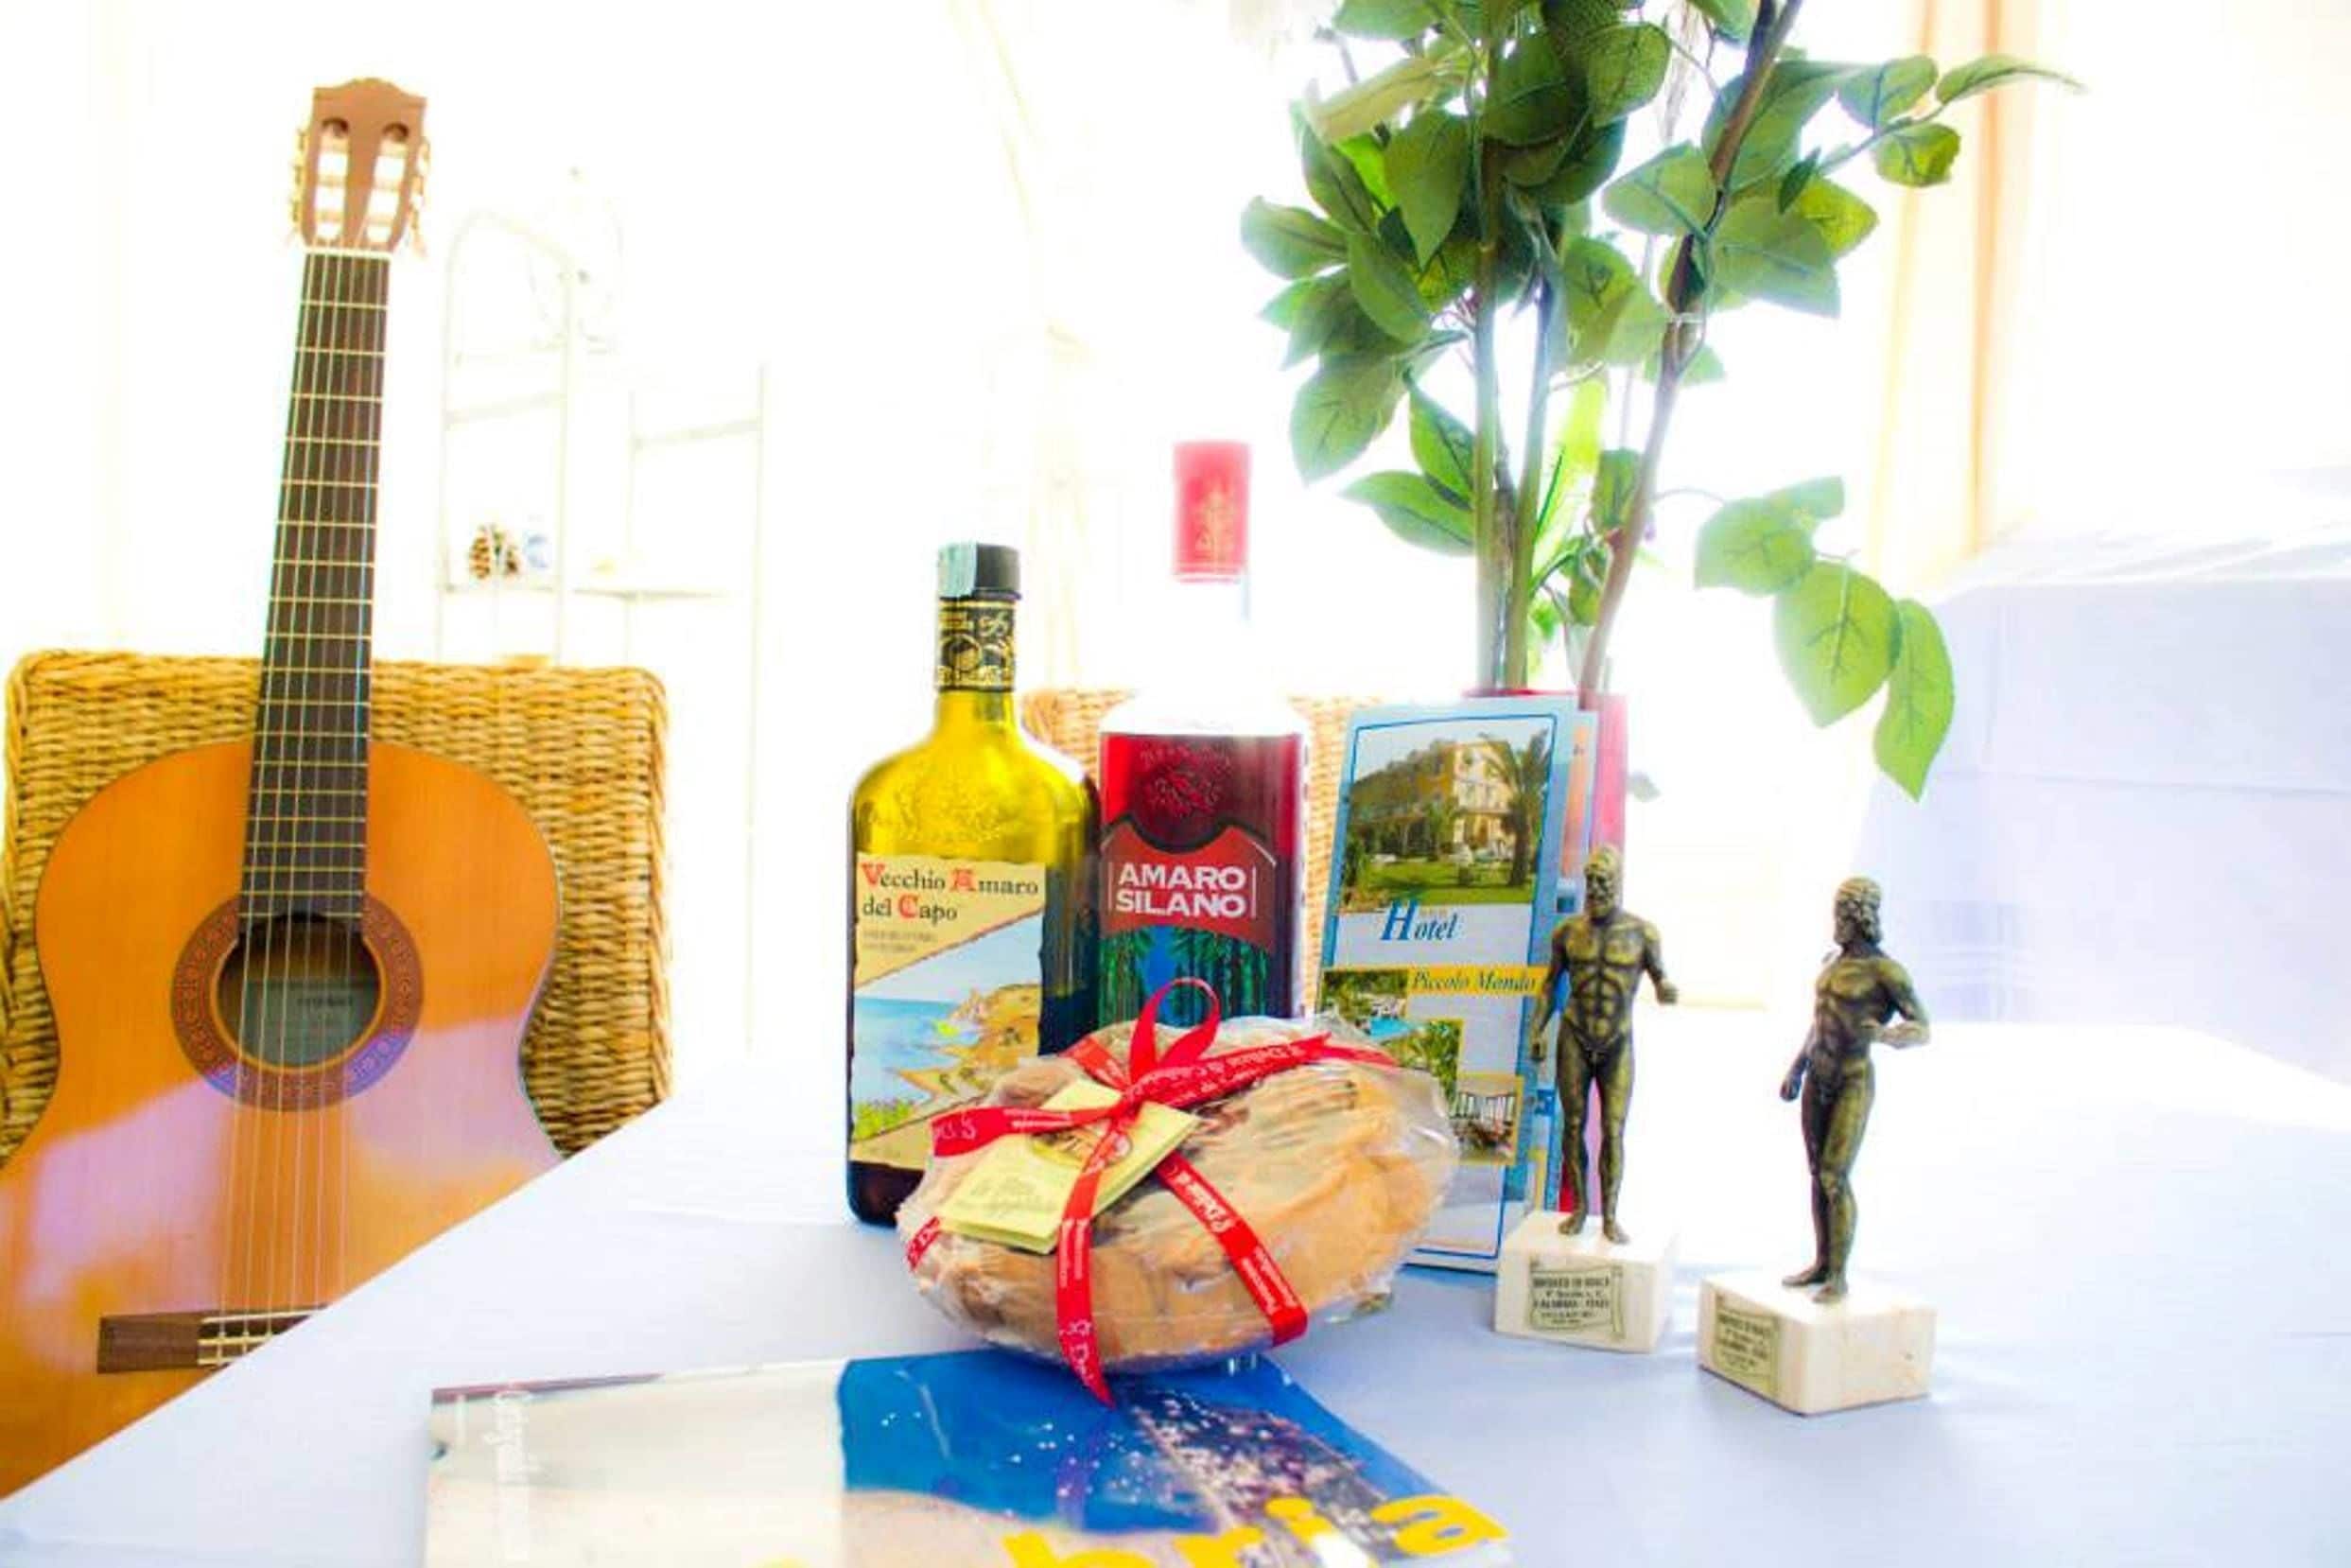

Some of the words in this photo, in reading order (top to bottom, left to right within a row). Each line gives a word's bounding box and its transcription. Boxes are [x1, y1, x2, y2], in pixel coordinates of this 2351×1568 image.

[862, 862, 946, 892] Vecchio
[949, 868, 1039, 894] Amaro
[1118, 862, 1246, 891] AMARO
[862, 896, 893, 918] del
[899, 894, 958, 925] Capo
[1115, 888, 1246, 917] SILANO
[1381, 898, 1458, 941] Hotel
[1413, 970, 1471, 990] Piccolo
[1477, 970, 1538, 992] Mondo
